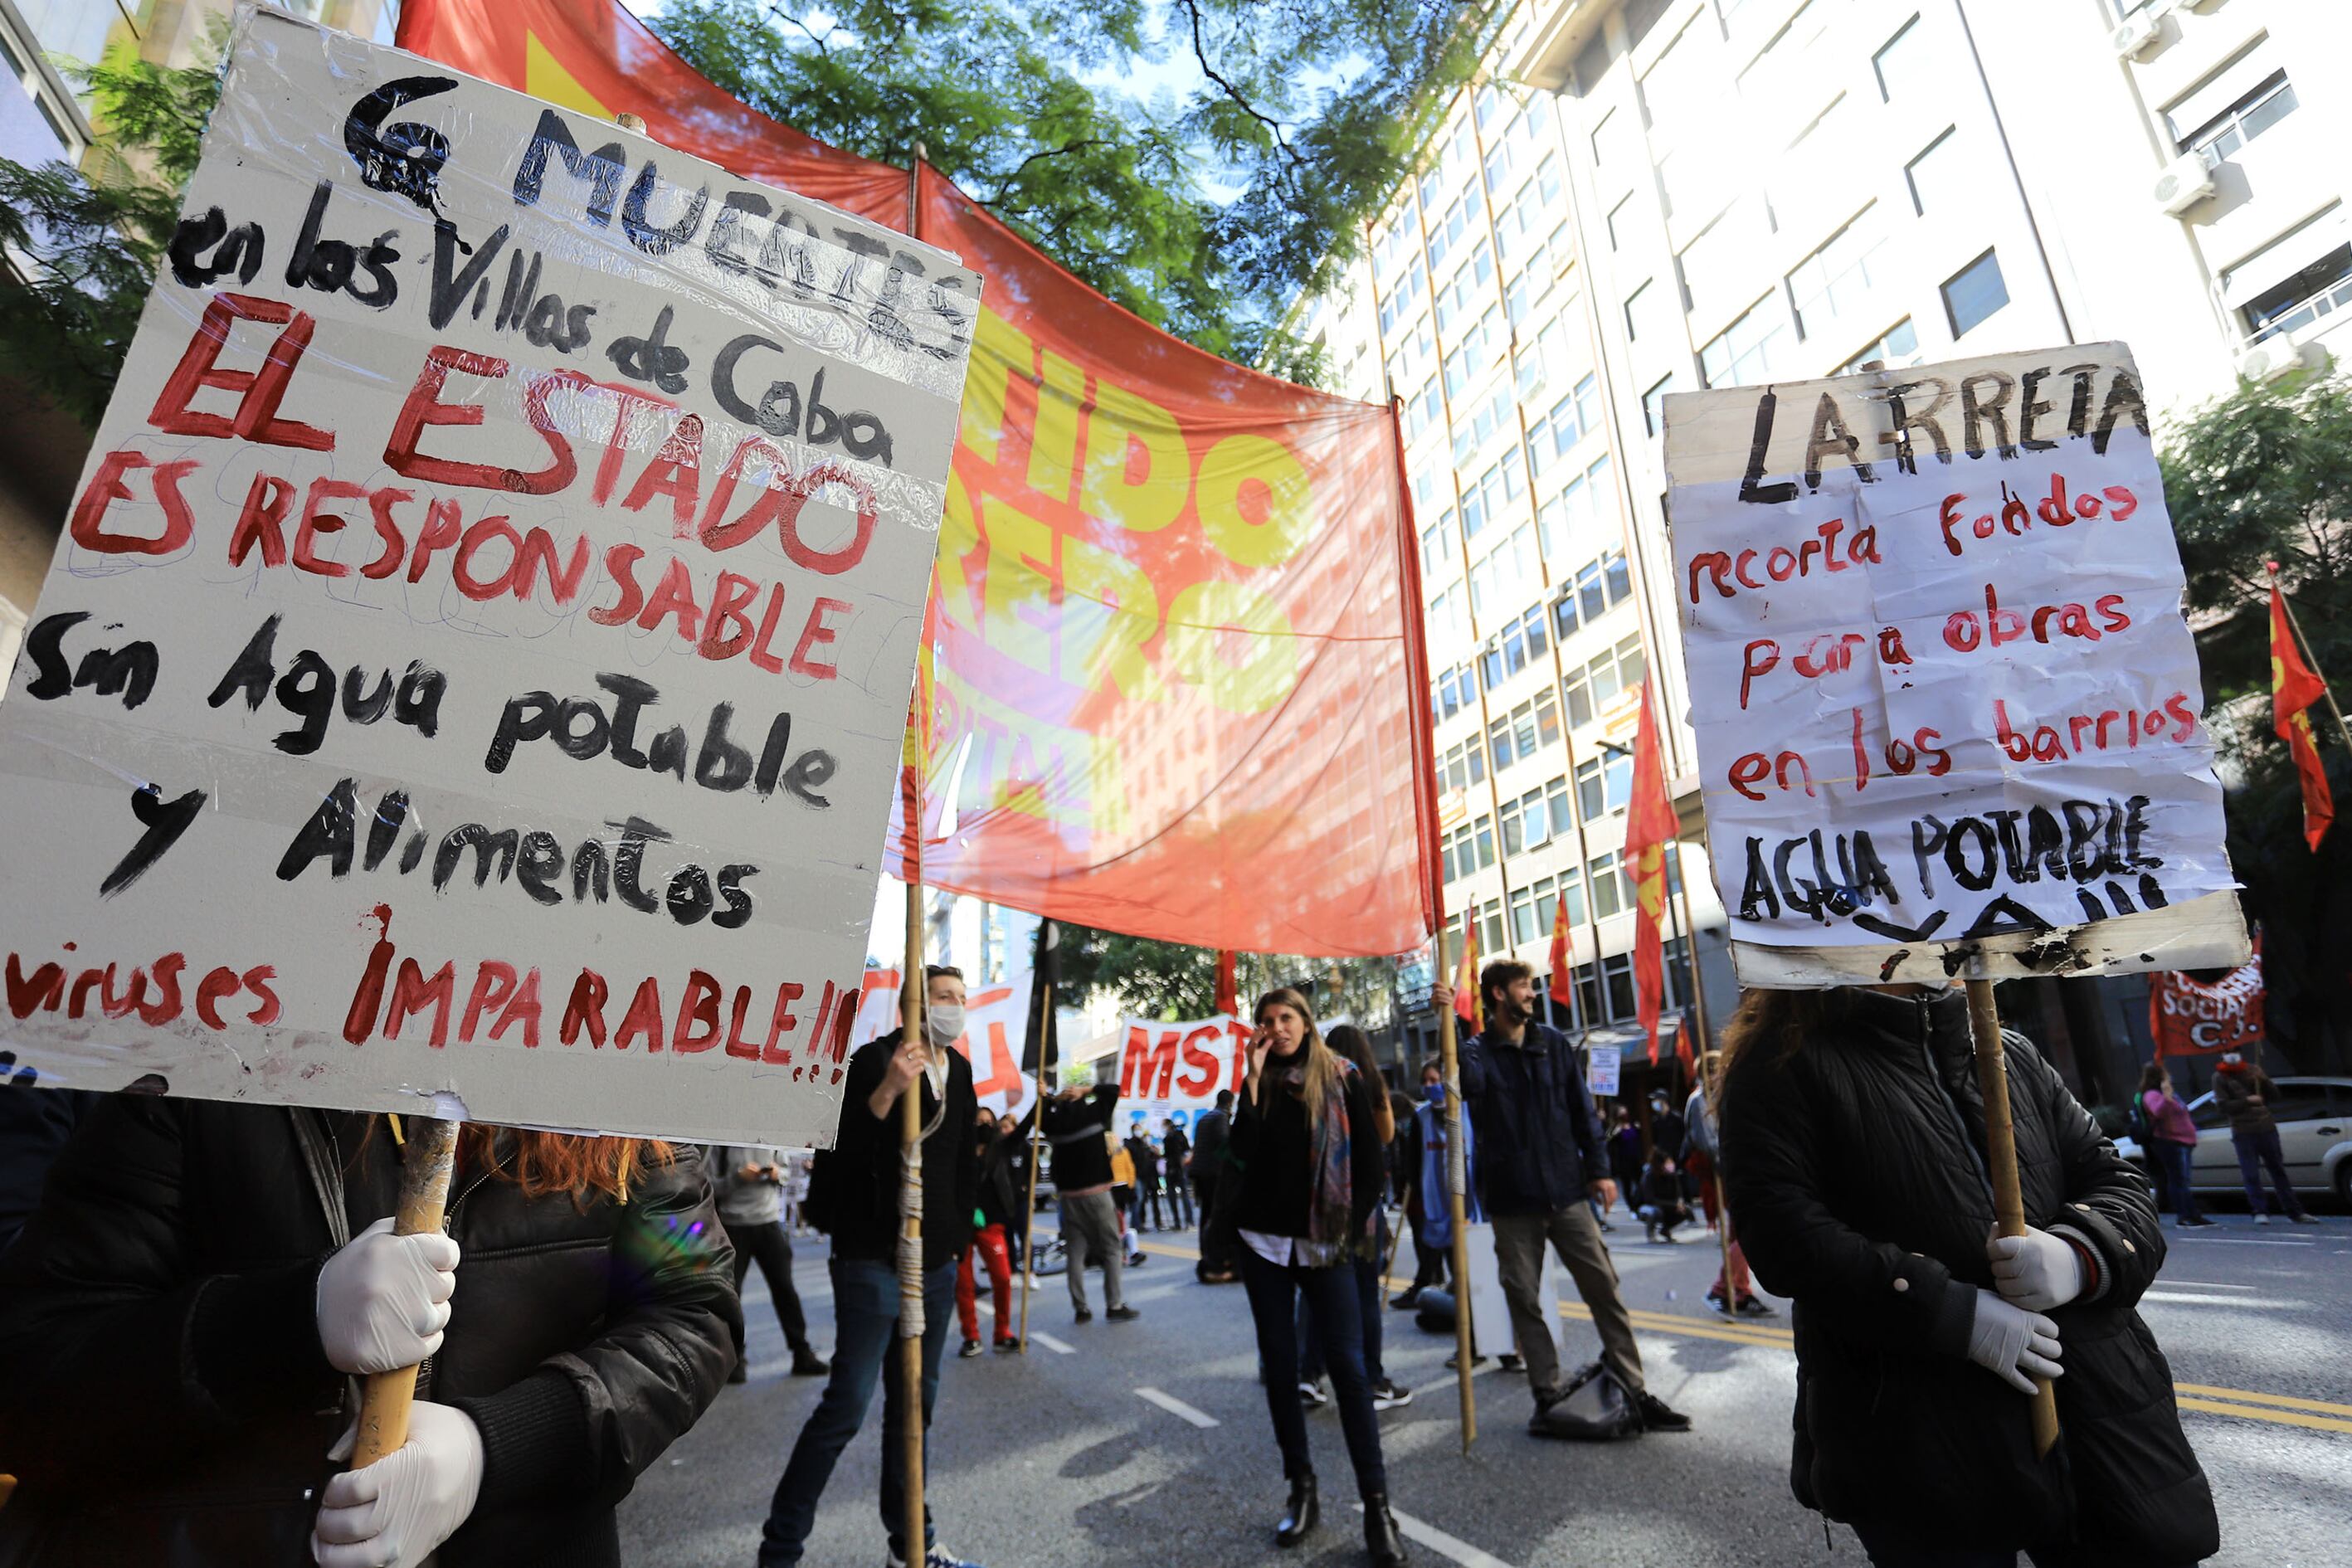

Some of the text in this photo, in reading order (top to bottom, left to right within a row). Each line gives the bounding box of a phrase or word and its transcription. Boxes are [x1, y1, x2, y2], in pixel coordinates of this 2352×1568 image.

[514, 109, 969, 360] MUERTES
[167, 205, 265, 289] en
[428, 219, 597, 354] Villas
[606, 303, 690, 395] de
[711, 334, 894, 468] Caba
[148, 292, 879, 575] EL ESTADO
[1740, 363, 2150, 503] LARRETA
[71, 451, 854, 680] ES RESPONSABLE
[1689, 519, 1882, 604] recorta
[27, 611, 841, 809] Sin Agua potable
[1741, 583, 2130, 710] para obras
[918, 665, 1093, 817] PITAL
[1728, 691, 2195, 801] en los barrios
[276, 777, 762, 928] Alimentos
[1739, 828, 1900, 923] AGUA
[1911, 794, 2165, 900] POTABLE
[1118, 1020, 1254, 1098] MST
